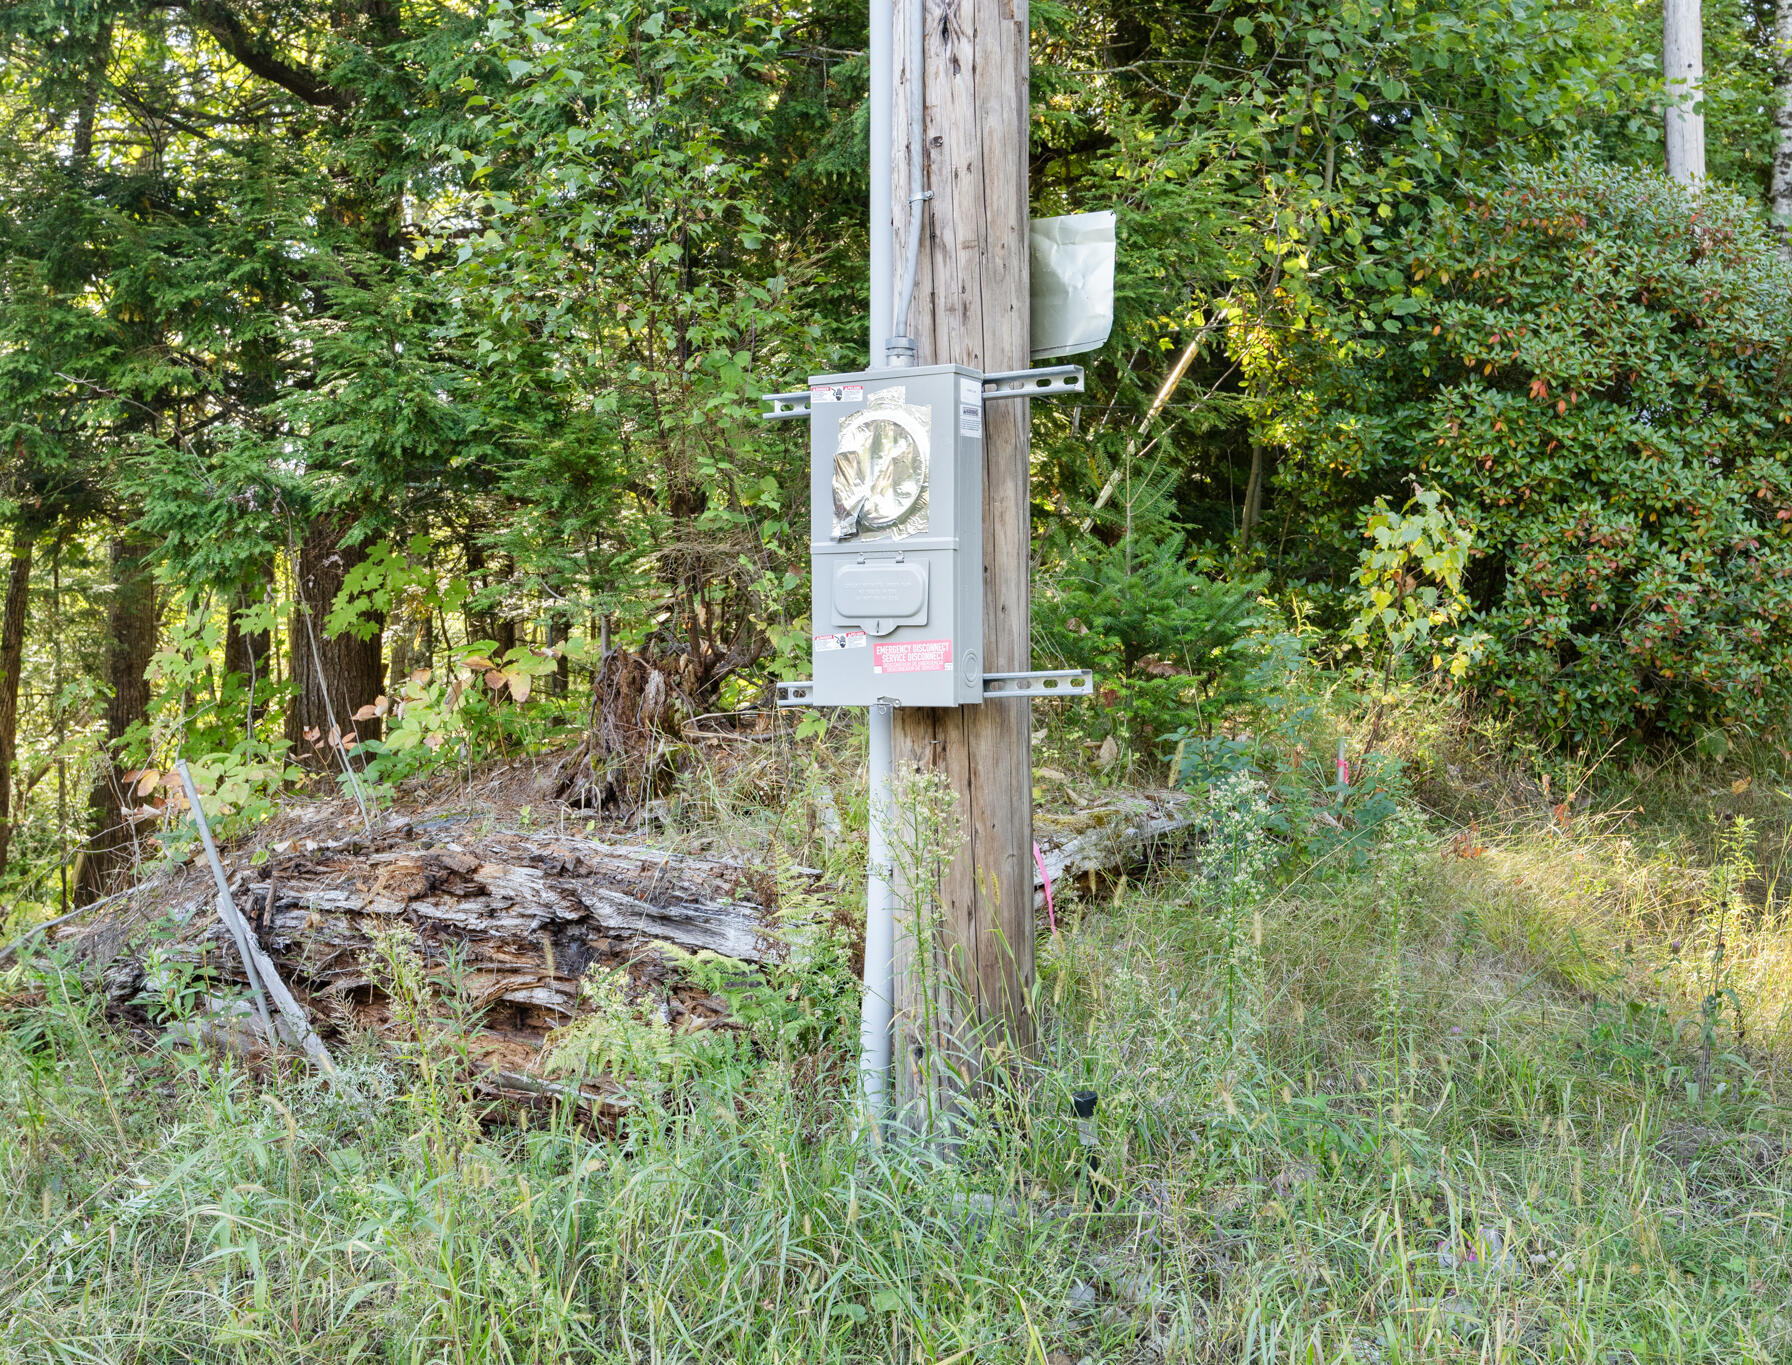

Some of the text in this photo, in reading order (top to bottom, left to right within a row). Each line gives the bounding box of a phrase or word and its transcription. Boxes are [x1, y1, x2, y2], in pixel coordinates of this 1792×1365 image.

[876, 642, 949, 654] EMERGENCY DISCONNECT
[882, 653, 906, 663] SERVICE
[907, 652, 944, 662] DISCONNECT
